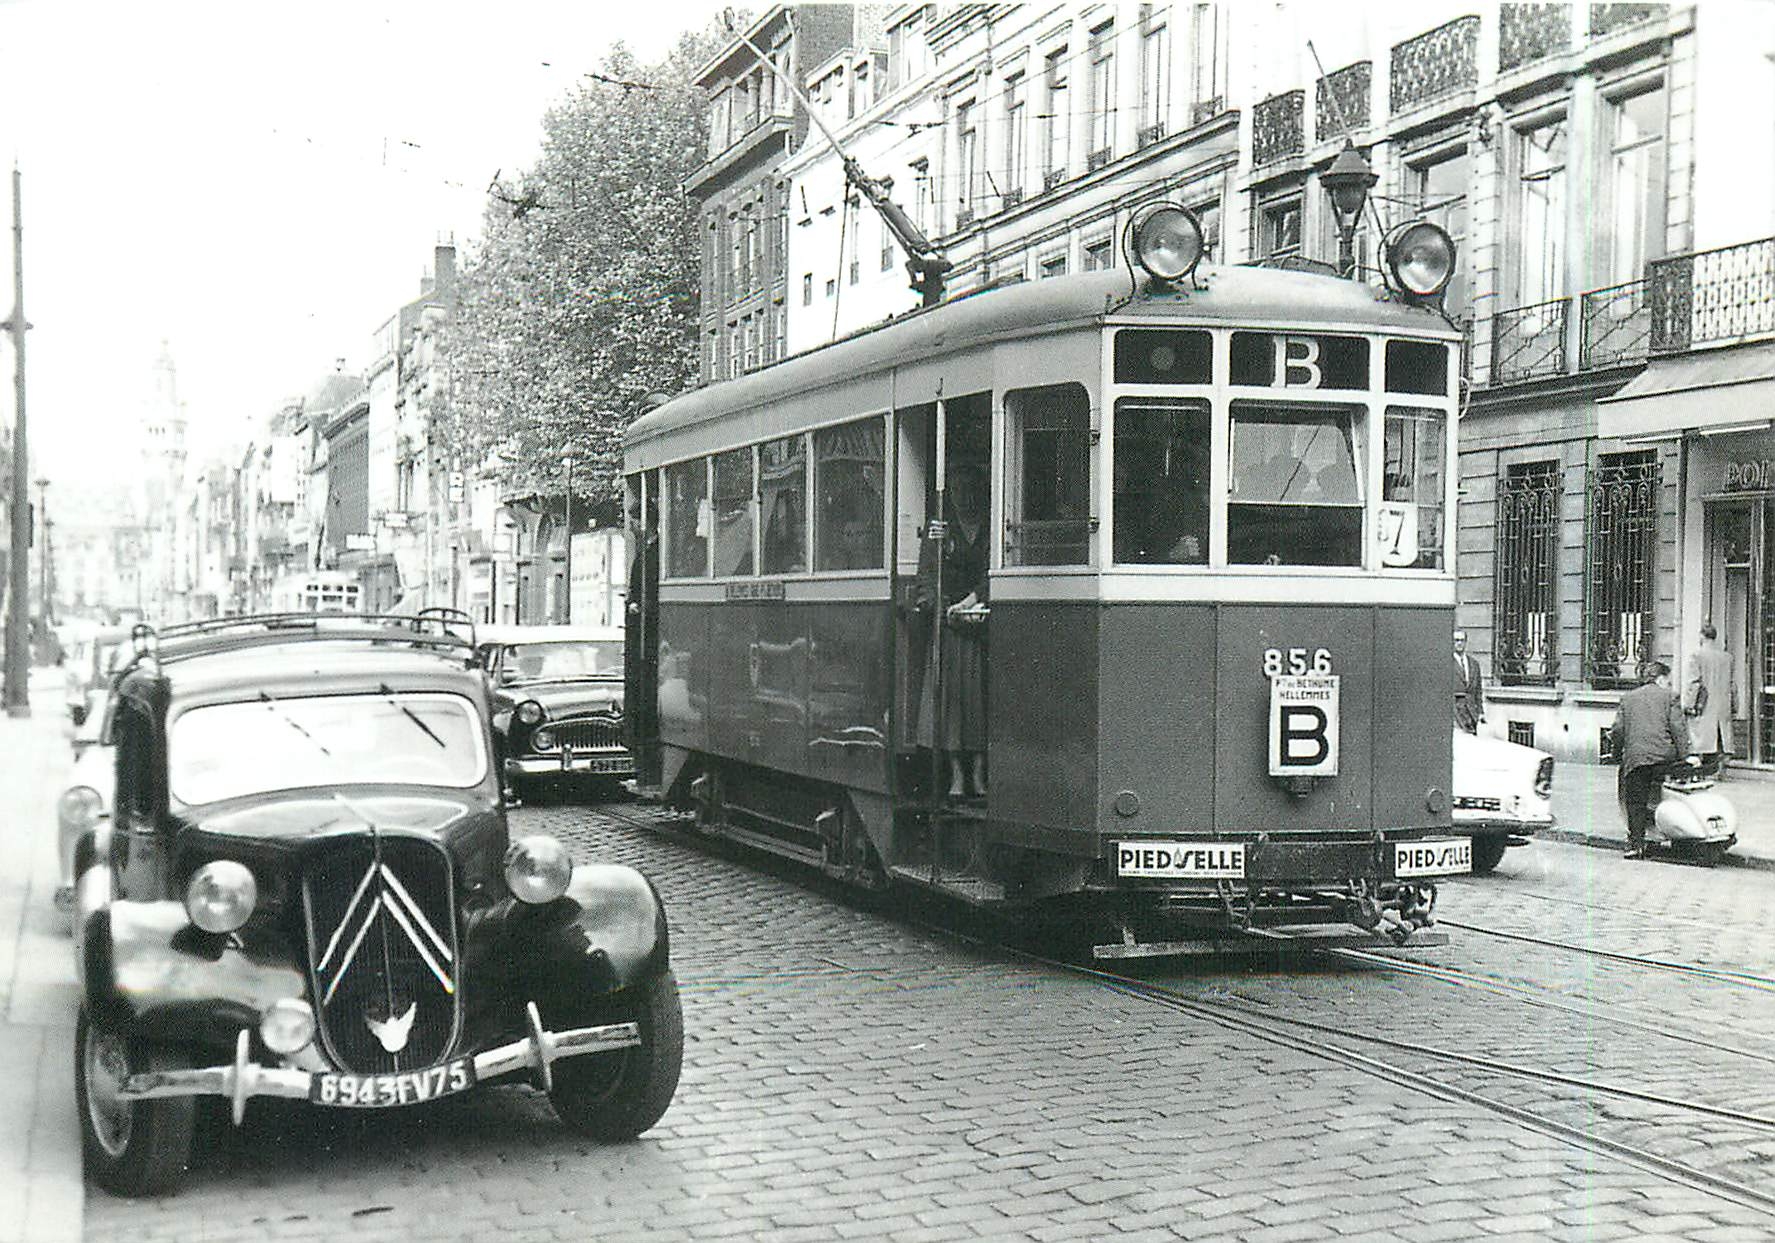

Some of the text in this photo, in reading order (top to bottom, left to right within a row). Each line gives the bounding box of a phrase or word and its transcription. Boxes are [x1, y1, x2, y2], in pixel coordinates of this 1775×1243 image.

[1271, 335, 1322, 389] B
[1263, 648, 1332, 677] 856
[1280, 691, 1330, 700] HELLEMMES
[1280, 705, 1329, 767] B
[321, 1059, 467, 1106] 6943FV75
